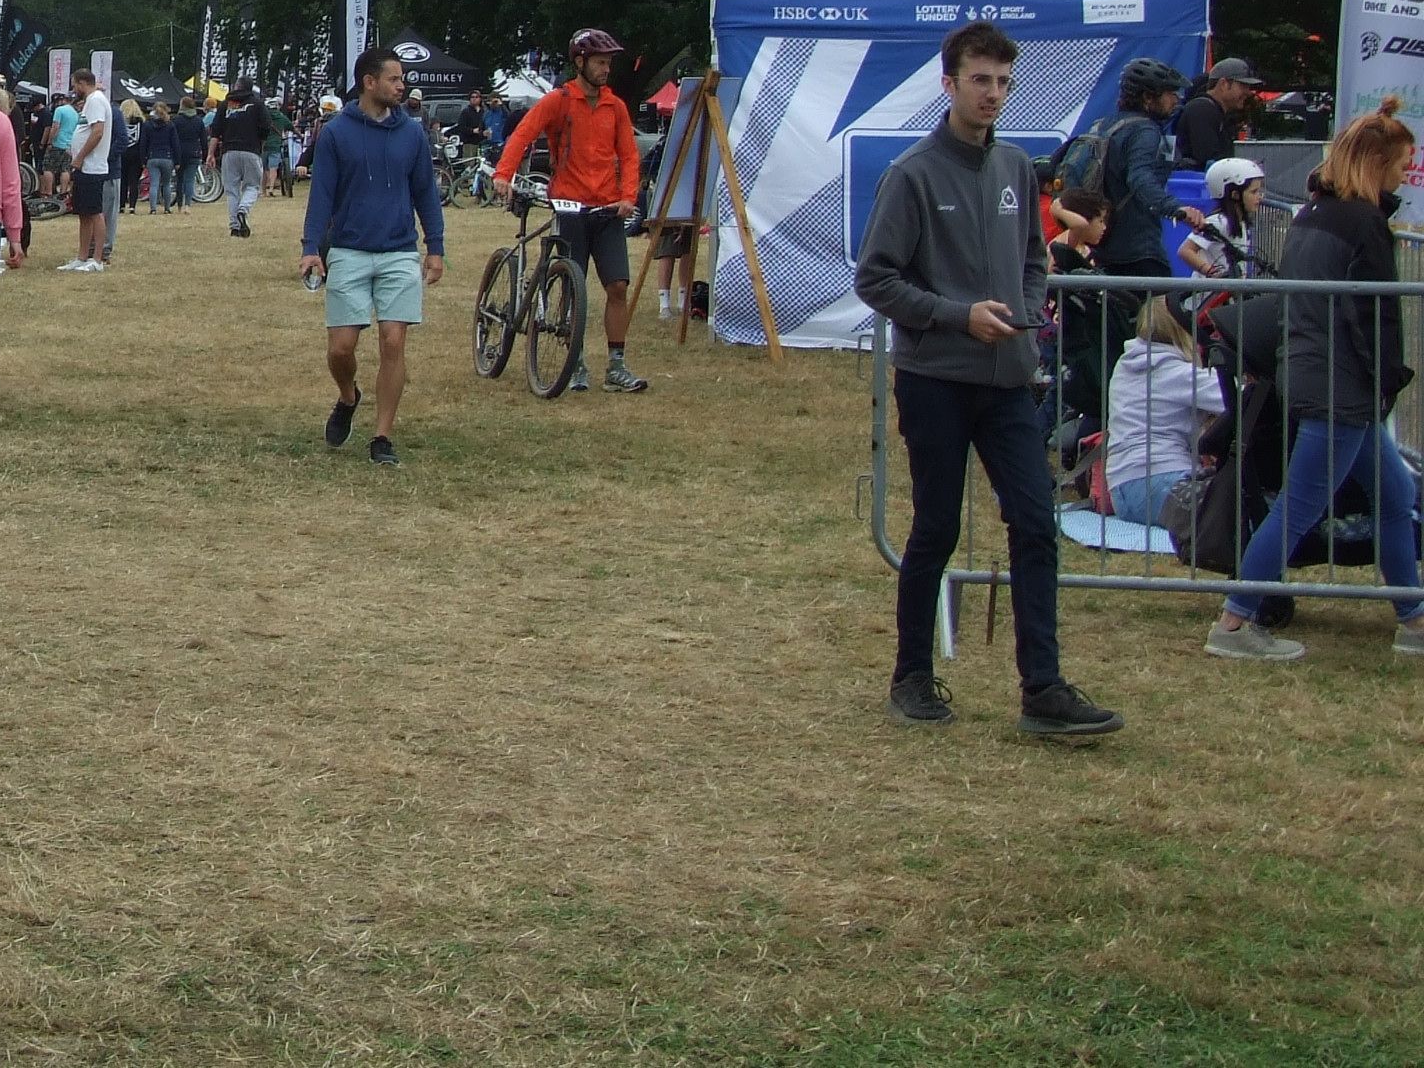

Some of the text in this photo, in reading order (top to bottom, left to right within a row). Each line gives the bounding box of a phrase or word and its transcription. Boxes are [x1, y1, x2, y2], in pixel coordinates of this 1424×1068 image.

[773, 7, 870, 21] HSBC UK
[916, 4, 961, 14] LOTTERY
[1364, 2, 1420, 17] BIKE AND
[916, 13, 958, 22] FUNDED
[1000, 12, 1036, 20] ENGLAND
